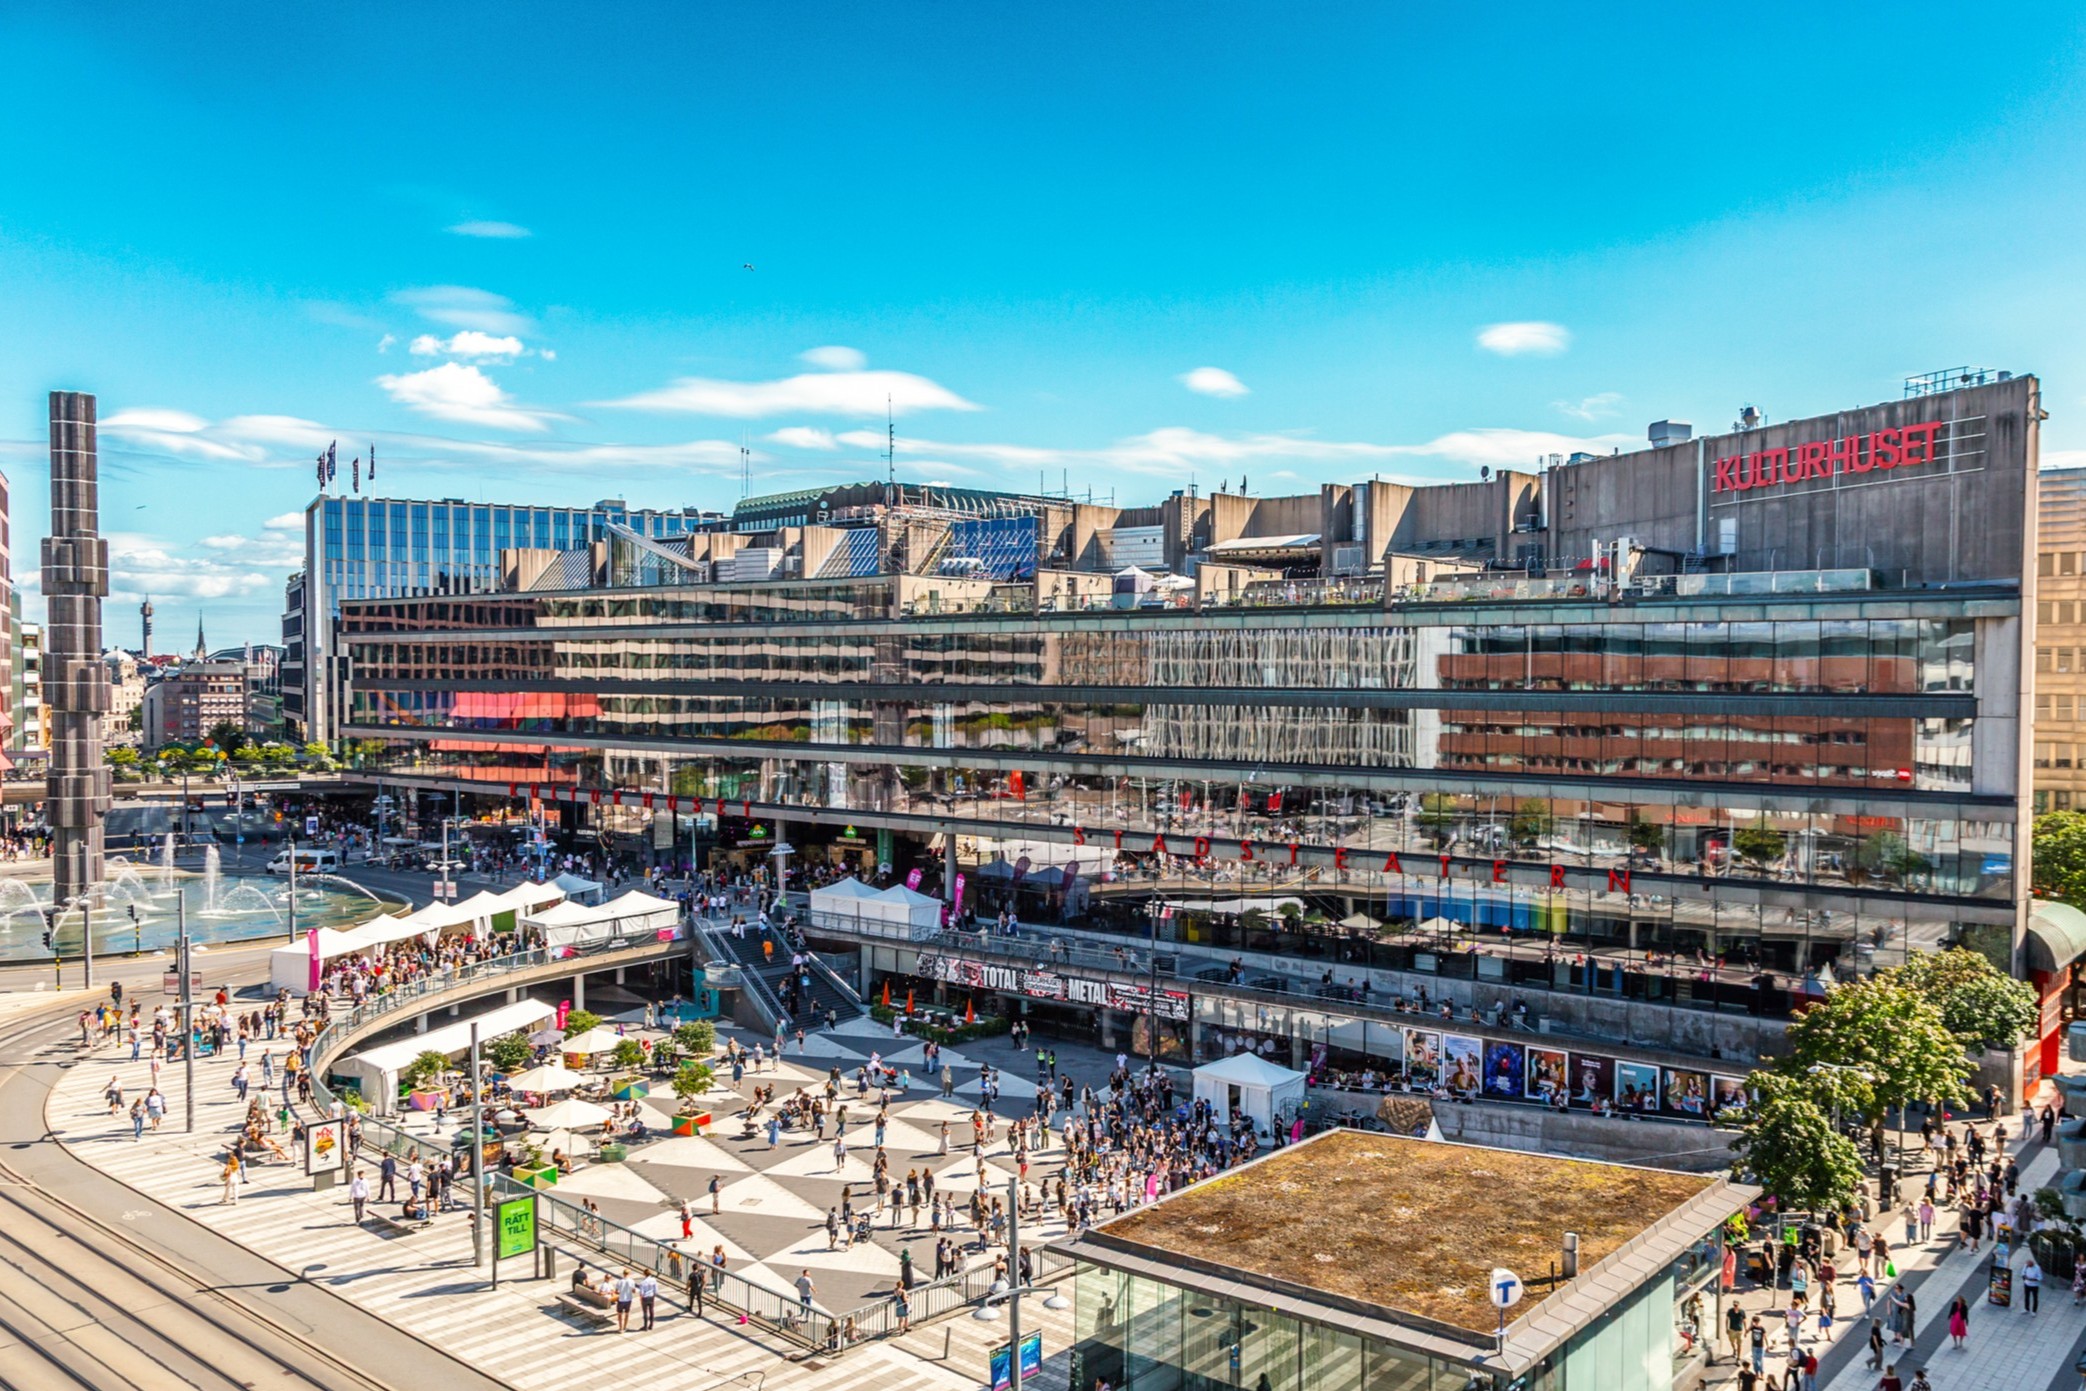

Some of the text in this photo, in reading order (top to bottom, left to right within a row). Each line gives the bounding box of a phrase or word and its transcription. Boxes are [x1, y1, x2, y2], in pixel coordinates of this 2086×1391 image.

[1715, 420, 1942, 493] KULTURHUSET
[509, 782, 752, 818] KULTURHUSET
[1073, 827, 1631, 893] STADSTEATERN
[982, 966, 1018, 991] TOTAL
[1068, 979, 1108, 1005] METAL
[505, 1212, 530, 1227] RÄTT
[507, 1224, 527, 1235] TILL
[1496, 1280, 1516, 1304] T
